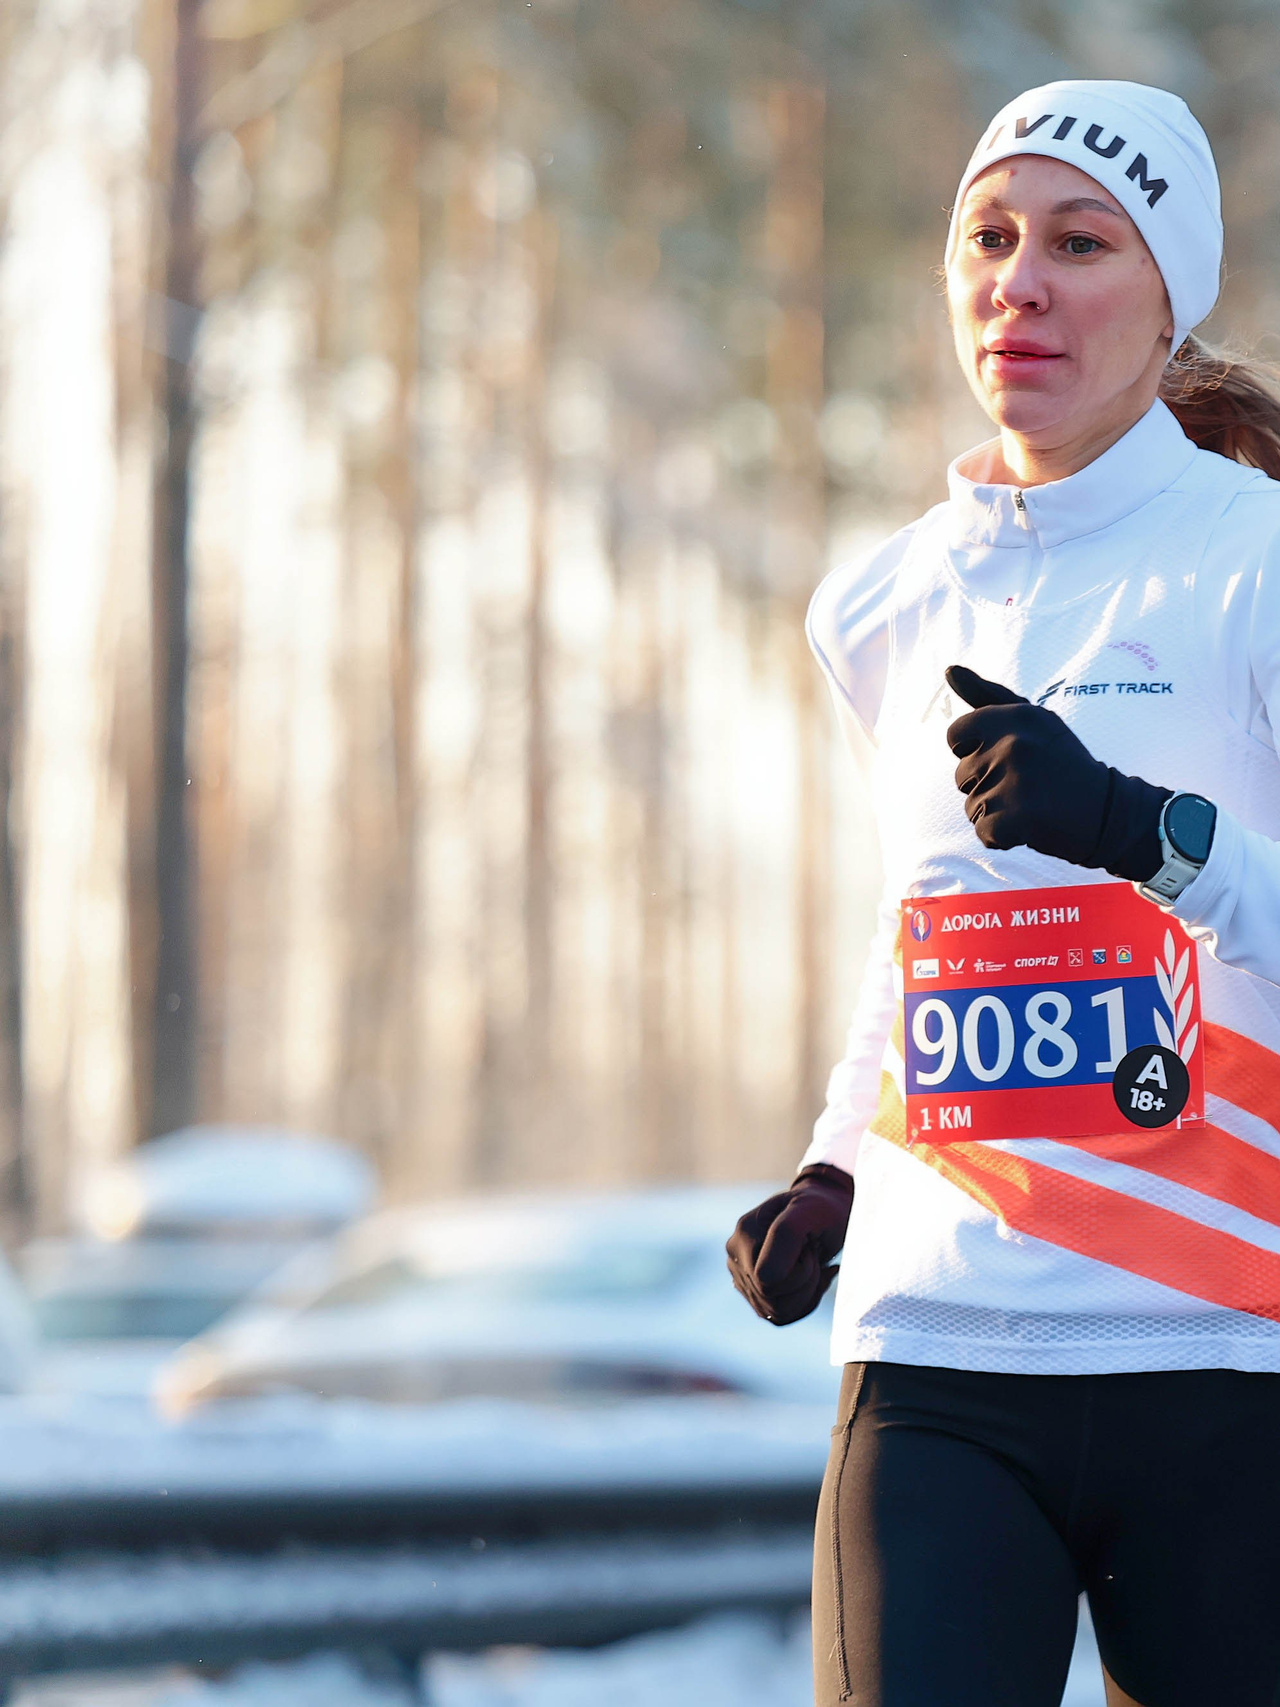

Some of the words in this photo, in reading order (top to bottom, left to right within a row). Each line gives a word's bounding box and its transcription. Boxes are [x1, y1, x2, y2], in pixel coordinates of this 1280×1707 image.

[1064, 683, 1110, 697] FIRST
[1116, 683, 1173, 694] TRACK
[941, 912, 1002, 932] ДОРОГА
[1010, 906, 1080, 927] ЖИЗНИ
[912, 986, 1128, 1086] 9081
[1130, 1088, 1166, 1111] 18+
[920, 1108, 931, 1130] 1
